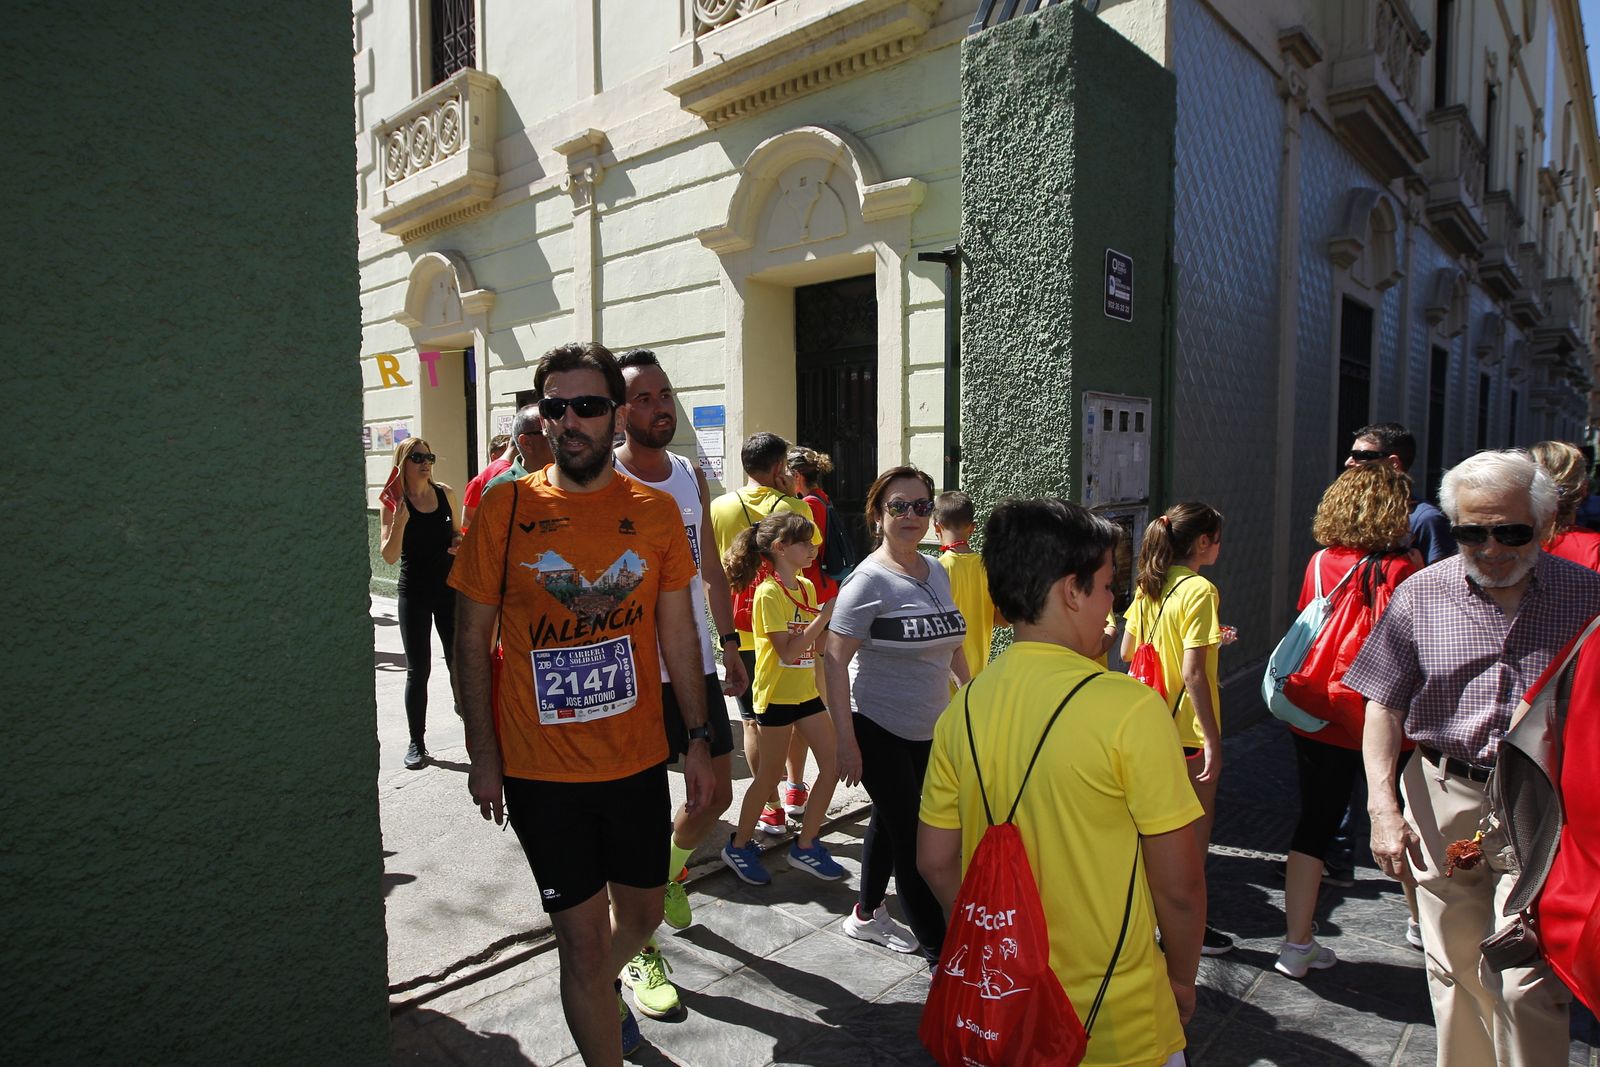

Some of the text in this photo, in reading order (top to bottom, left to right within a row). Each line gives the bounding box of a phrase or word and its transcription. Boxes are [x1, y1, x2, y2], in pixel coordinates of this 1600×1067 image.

[568, 647, 605, 659] CARRERA
[569, 653, 606, 665] SOLIDARIA
[545, 663, 618, 696] 2147
[565, 696, 583, 707] JOSE
[583, 690, 616, 706] ANTONIO
